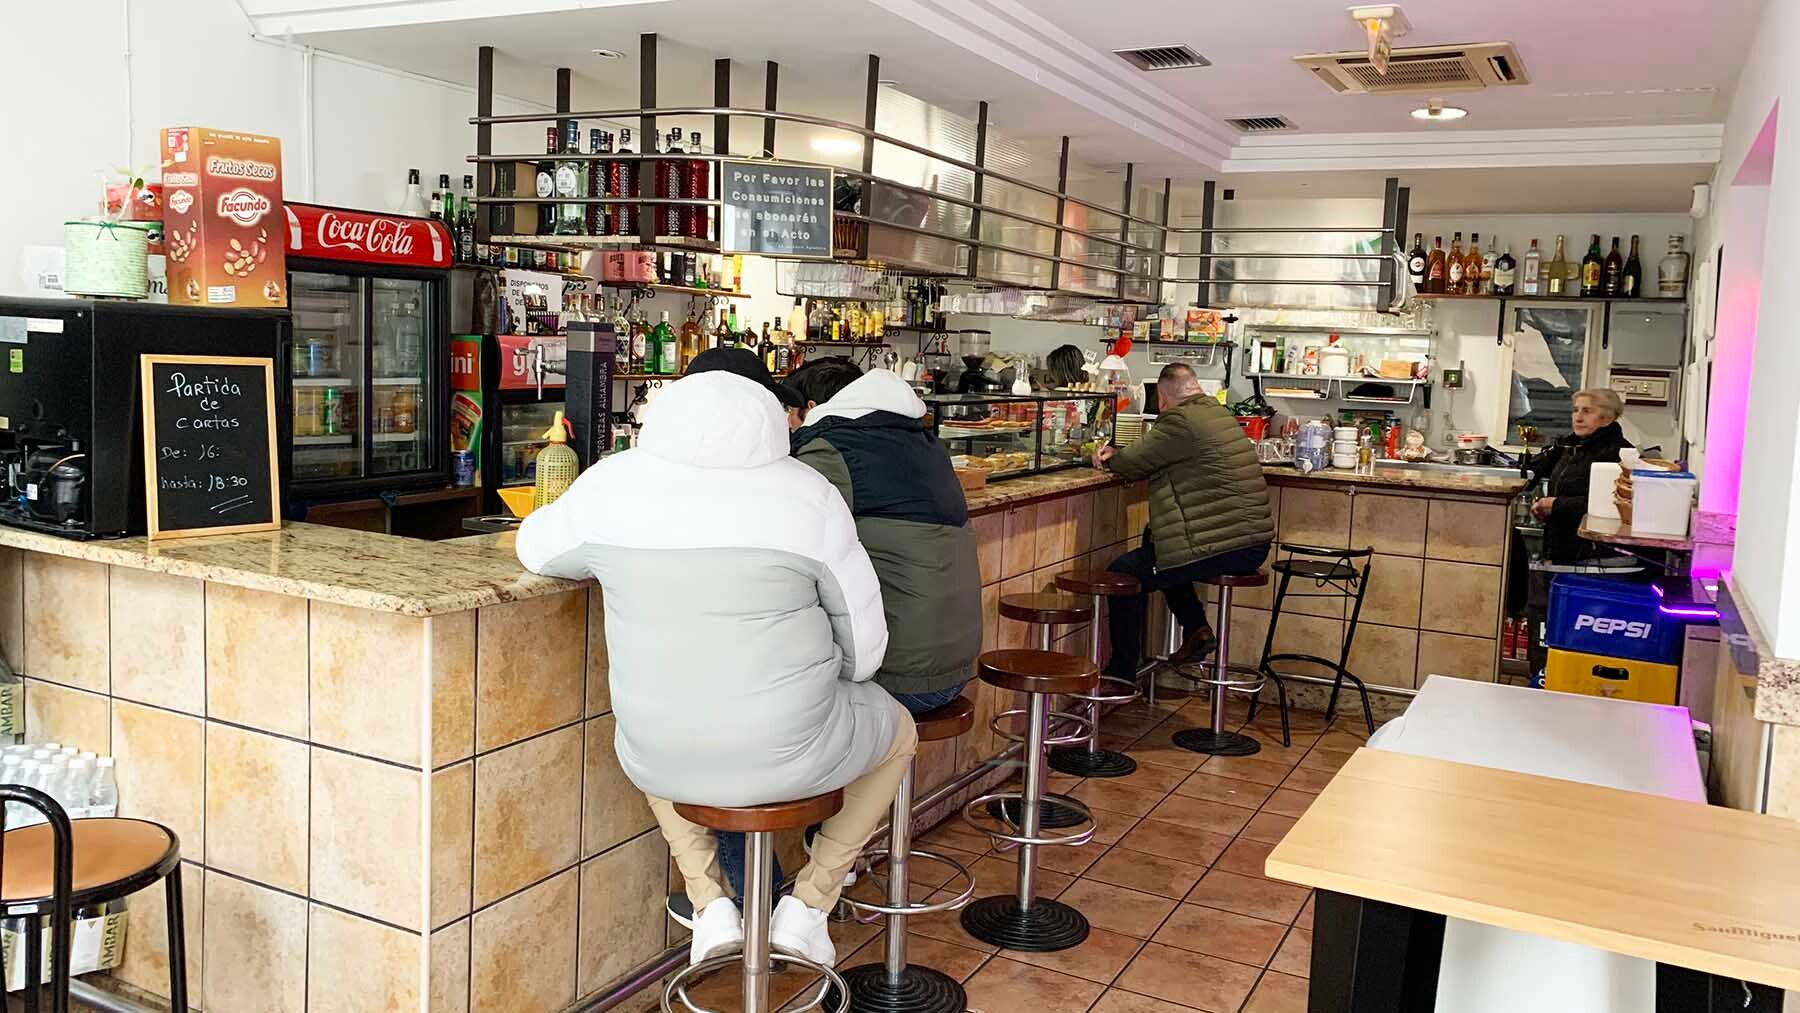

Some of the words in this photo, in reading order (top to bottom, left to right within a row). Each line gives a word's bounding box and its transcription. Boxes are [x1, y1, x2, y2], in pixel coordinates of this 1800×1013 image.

[210, 160, 244, 175] Frutos
[244, 162, 274, 178] Secos
[733, 171, 757, 183] Por
[221, 196, 267, 213] Facundo
[732, 191, 825, 206] Consumiciones
[756, 211, 817, 223] abonarén
[317, 212, 413, 255] Coca-Cola
[781, 229, 810, 240] Acto
[200, 396, 221, 411] de
[207, 474, 248, 492] 18:30
[1574, 614, 1652, 639] PEPSI
[1, 687, 14, 737] AMBAR
[102, 914, 120, 968] AMBAR
